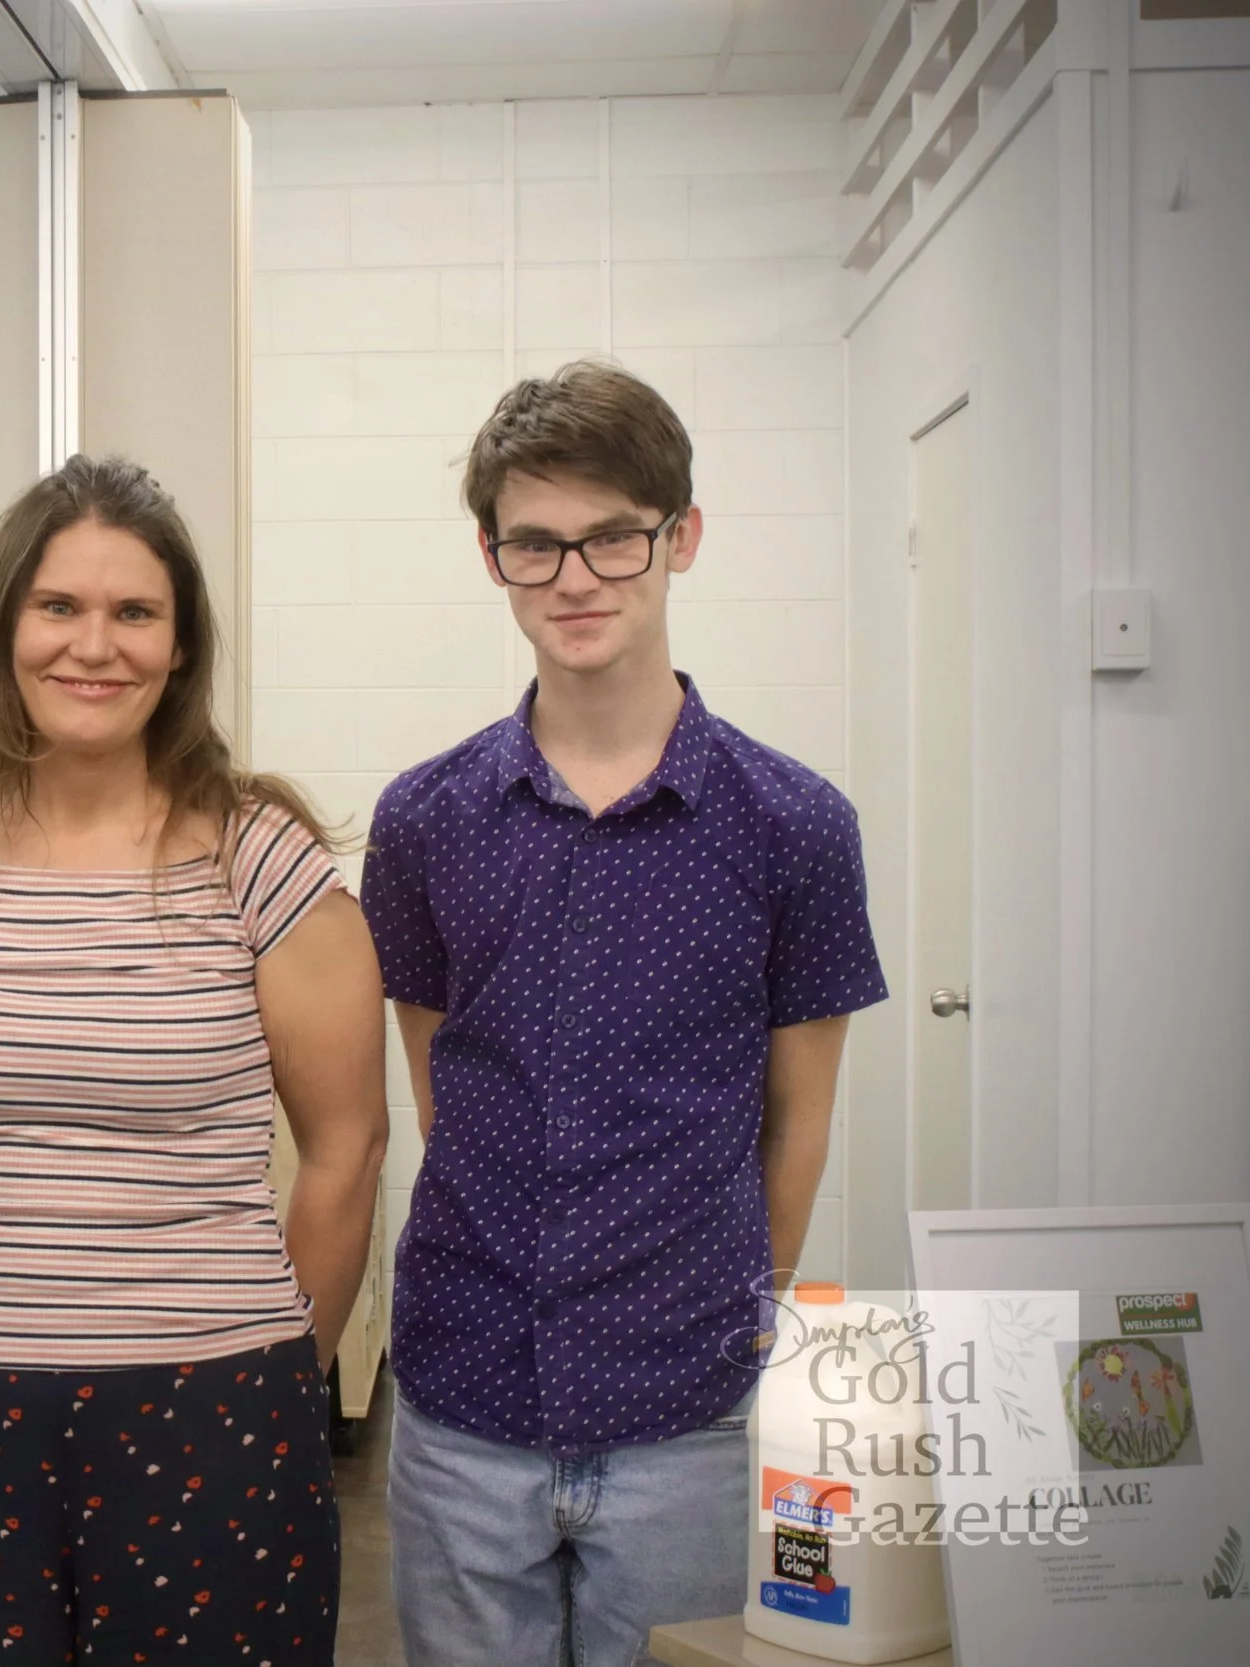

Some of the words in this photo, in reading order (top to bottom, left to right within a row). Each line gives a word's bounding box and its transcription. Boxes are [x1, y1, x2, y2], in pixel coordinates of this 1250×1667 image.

[1119, 1293, 1188, 1313] prospect
[1123, 1318, 1175, 1331] WELLNESS
[1177, 1317, 1198, 1329] HUB
[1029, 1482, 1153, 1509] COLLAGE
[777, 1501, 830, 1523] ELMER'S
[778, 1537, 825, 1562] School
[782, 1555, 813, 1577] Glue
